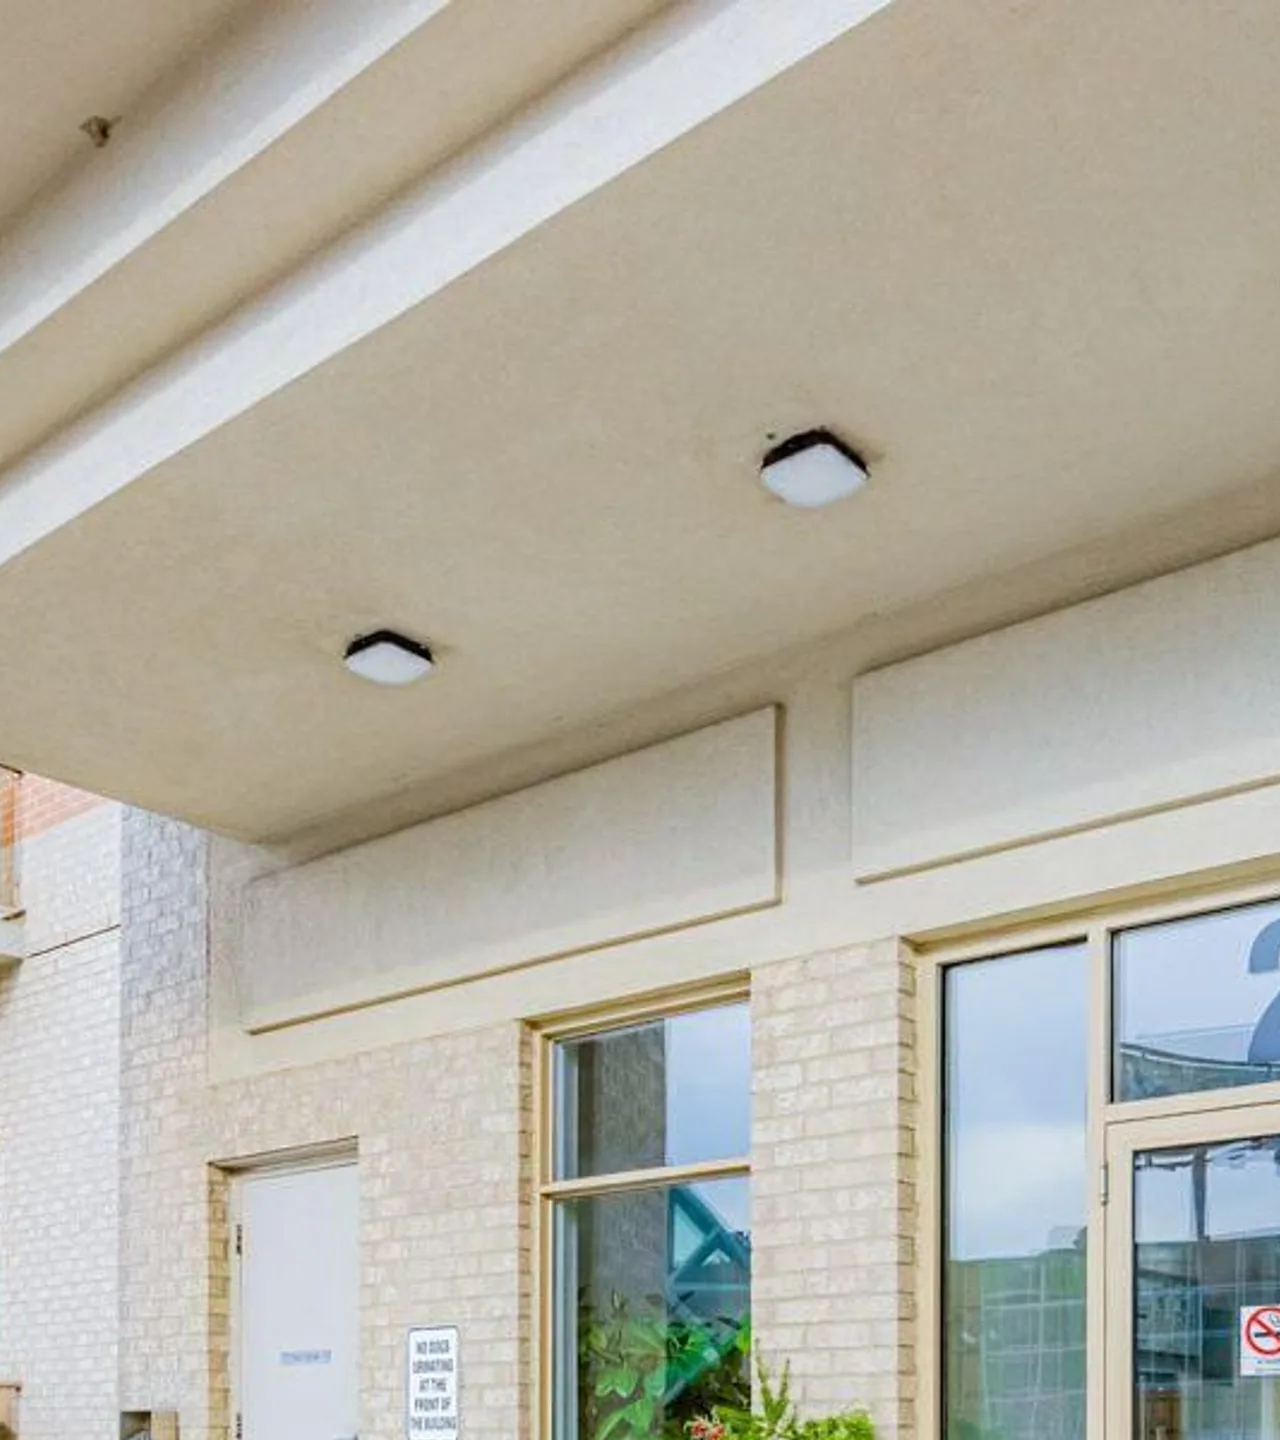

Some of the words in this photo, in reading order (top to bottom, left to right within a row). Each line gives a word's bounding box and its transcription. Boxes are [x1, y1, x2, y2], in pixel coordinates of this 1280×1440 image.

[414, 1398, 439, 1411] FRONT
[441, 1397, 451, 1410] OF
[424, 1416, 457, 1430] BUILDING
